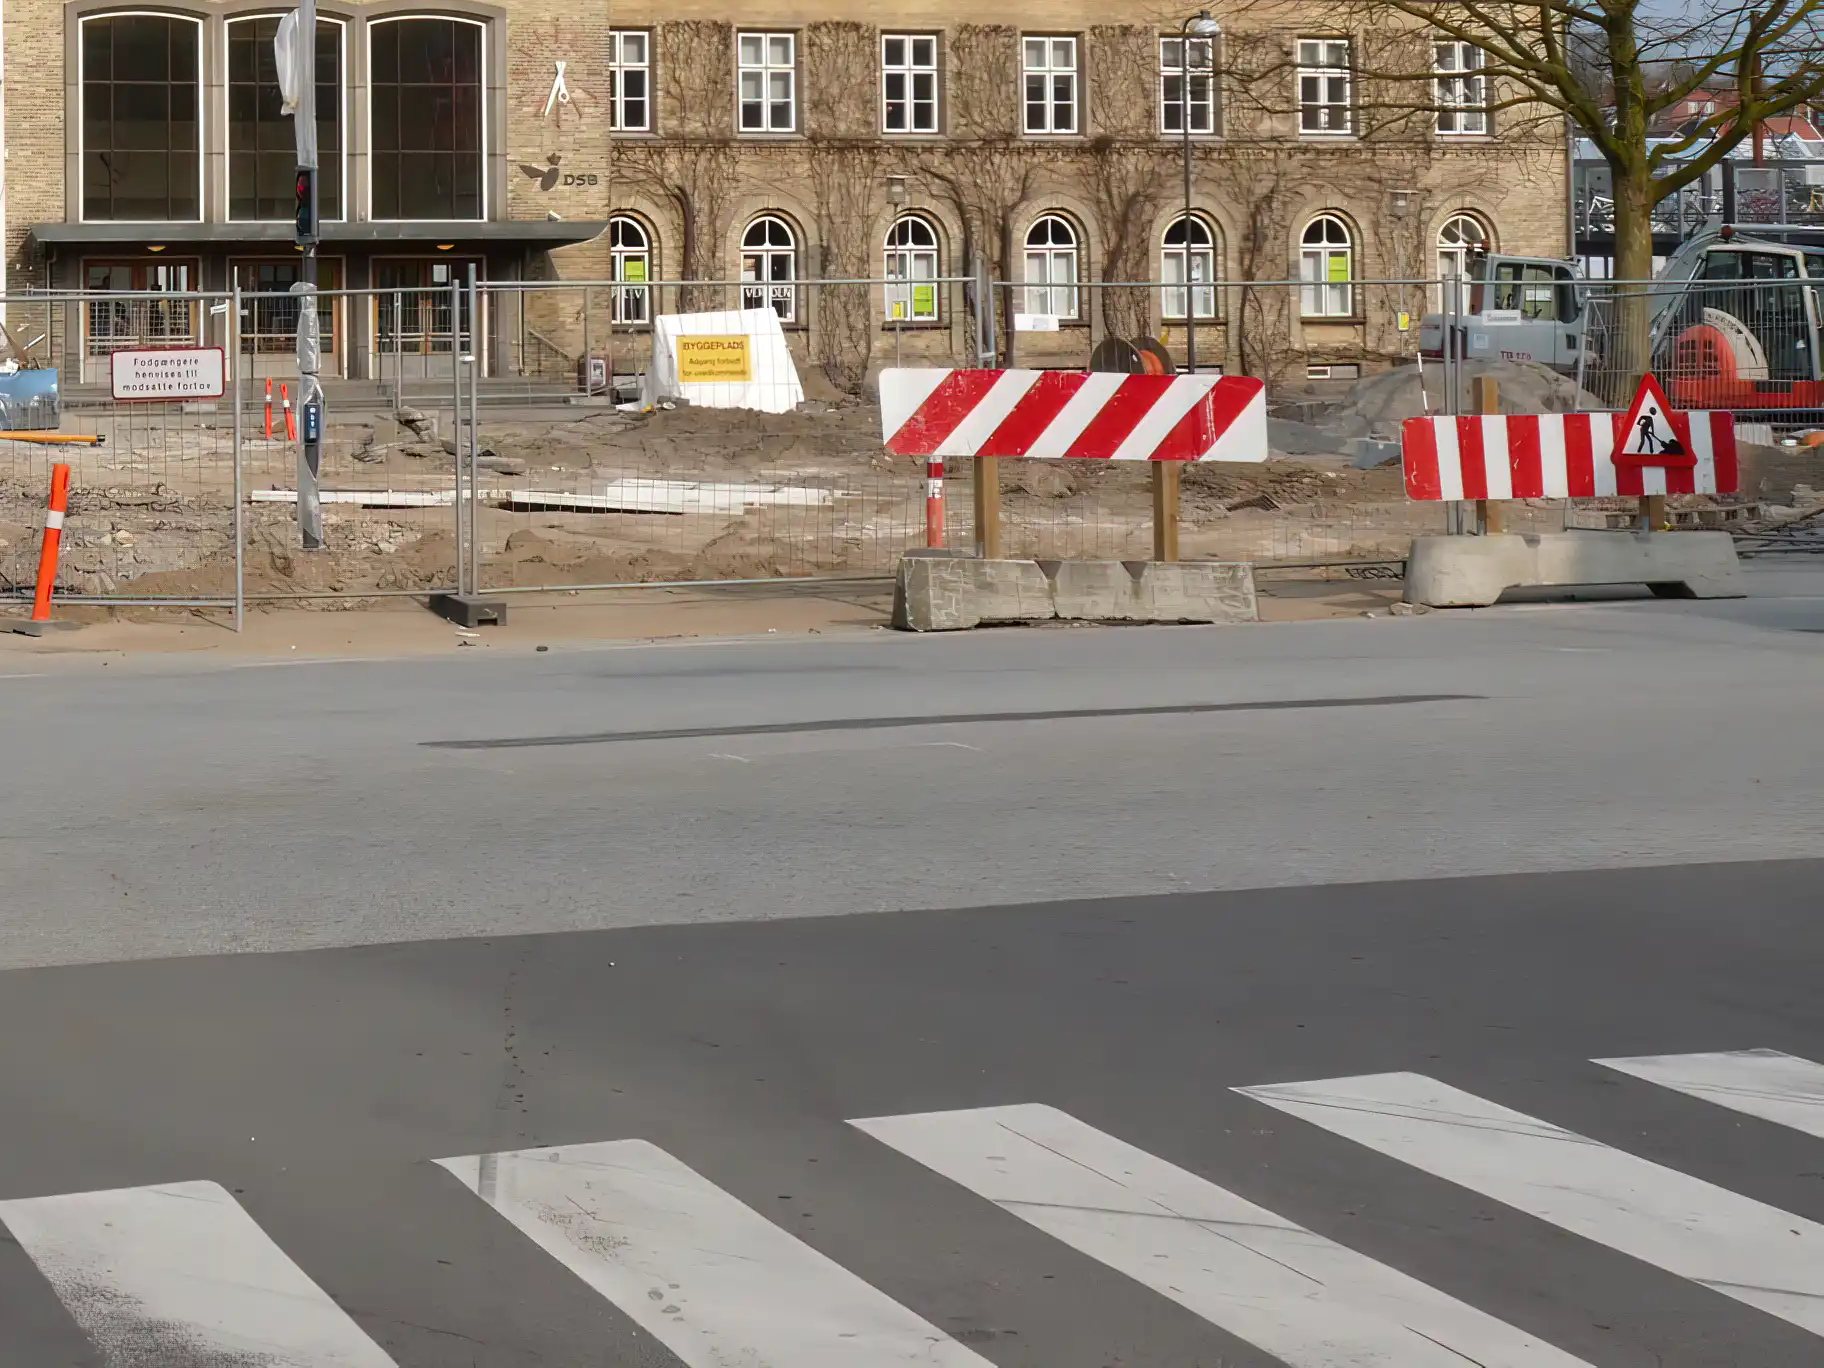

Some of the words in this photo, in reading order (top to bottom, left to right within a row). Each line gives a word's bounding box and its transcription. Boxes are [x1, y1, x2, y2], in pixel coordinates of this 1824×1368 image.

[563, 174, 598, 187] DSB
[682, 341, 745, 350] BYGGEPLADS
[133, 358, 199, 367] Fodgængere
[135, 370, 182, 379] henvises
[186, 369, 198, 378] til
[122, 383, 173, 391] modsatte
[177, 382, 211, 391] fortov
